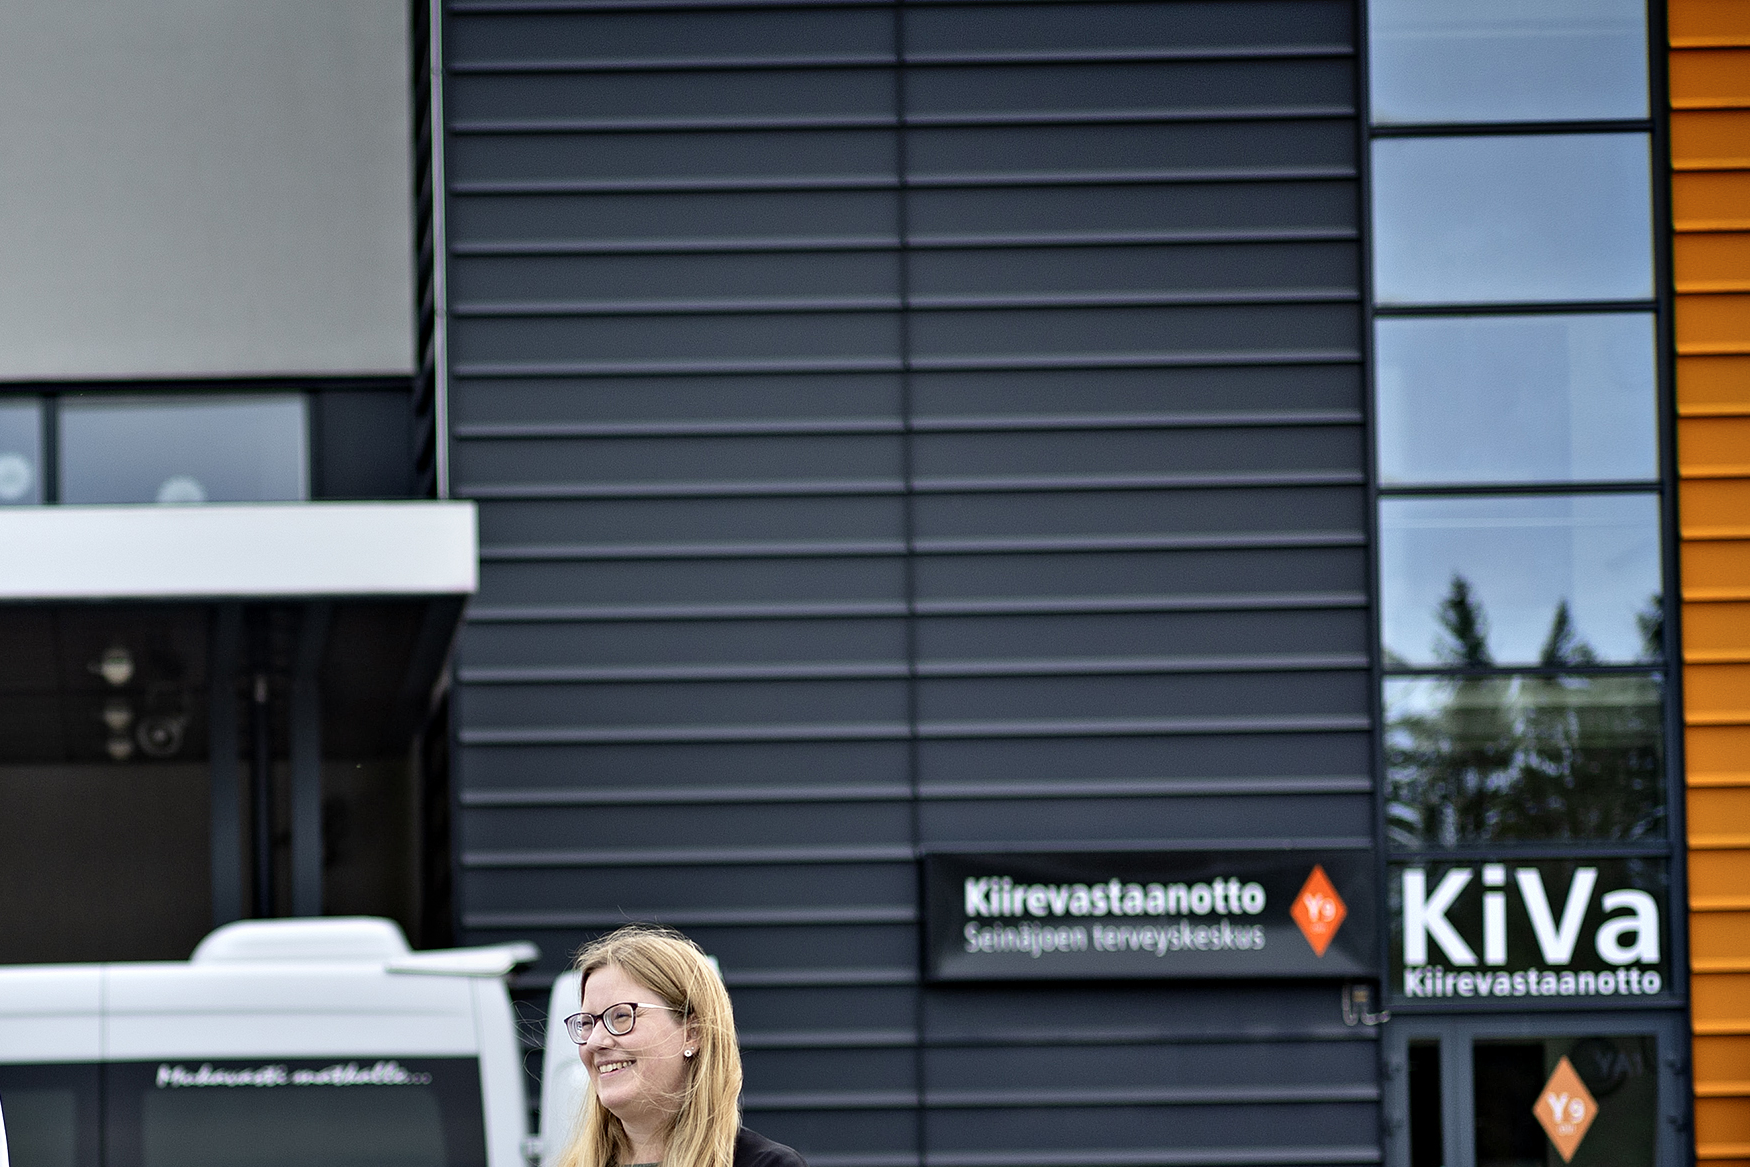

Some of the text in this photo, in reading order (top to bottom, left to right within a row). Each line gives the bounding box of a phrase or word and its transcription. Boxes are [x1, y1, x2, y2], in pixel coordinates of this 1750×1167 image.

[964, 876, 1267, 918] Kiirevastaanotto
[1302, 892, 1337, 922] Y9
[1402, 863, 1660, 966] KiVa
[964, 918, 1266, 959] Seinäjoen terveyskeskus
[1403, 965, 1662, 998] Kiirevastaanotto
[1547, 1092, 1586, 1124] Y9
